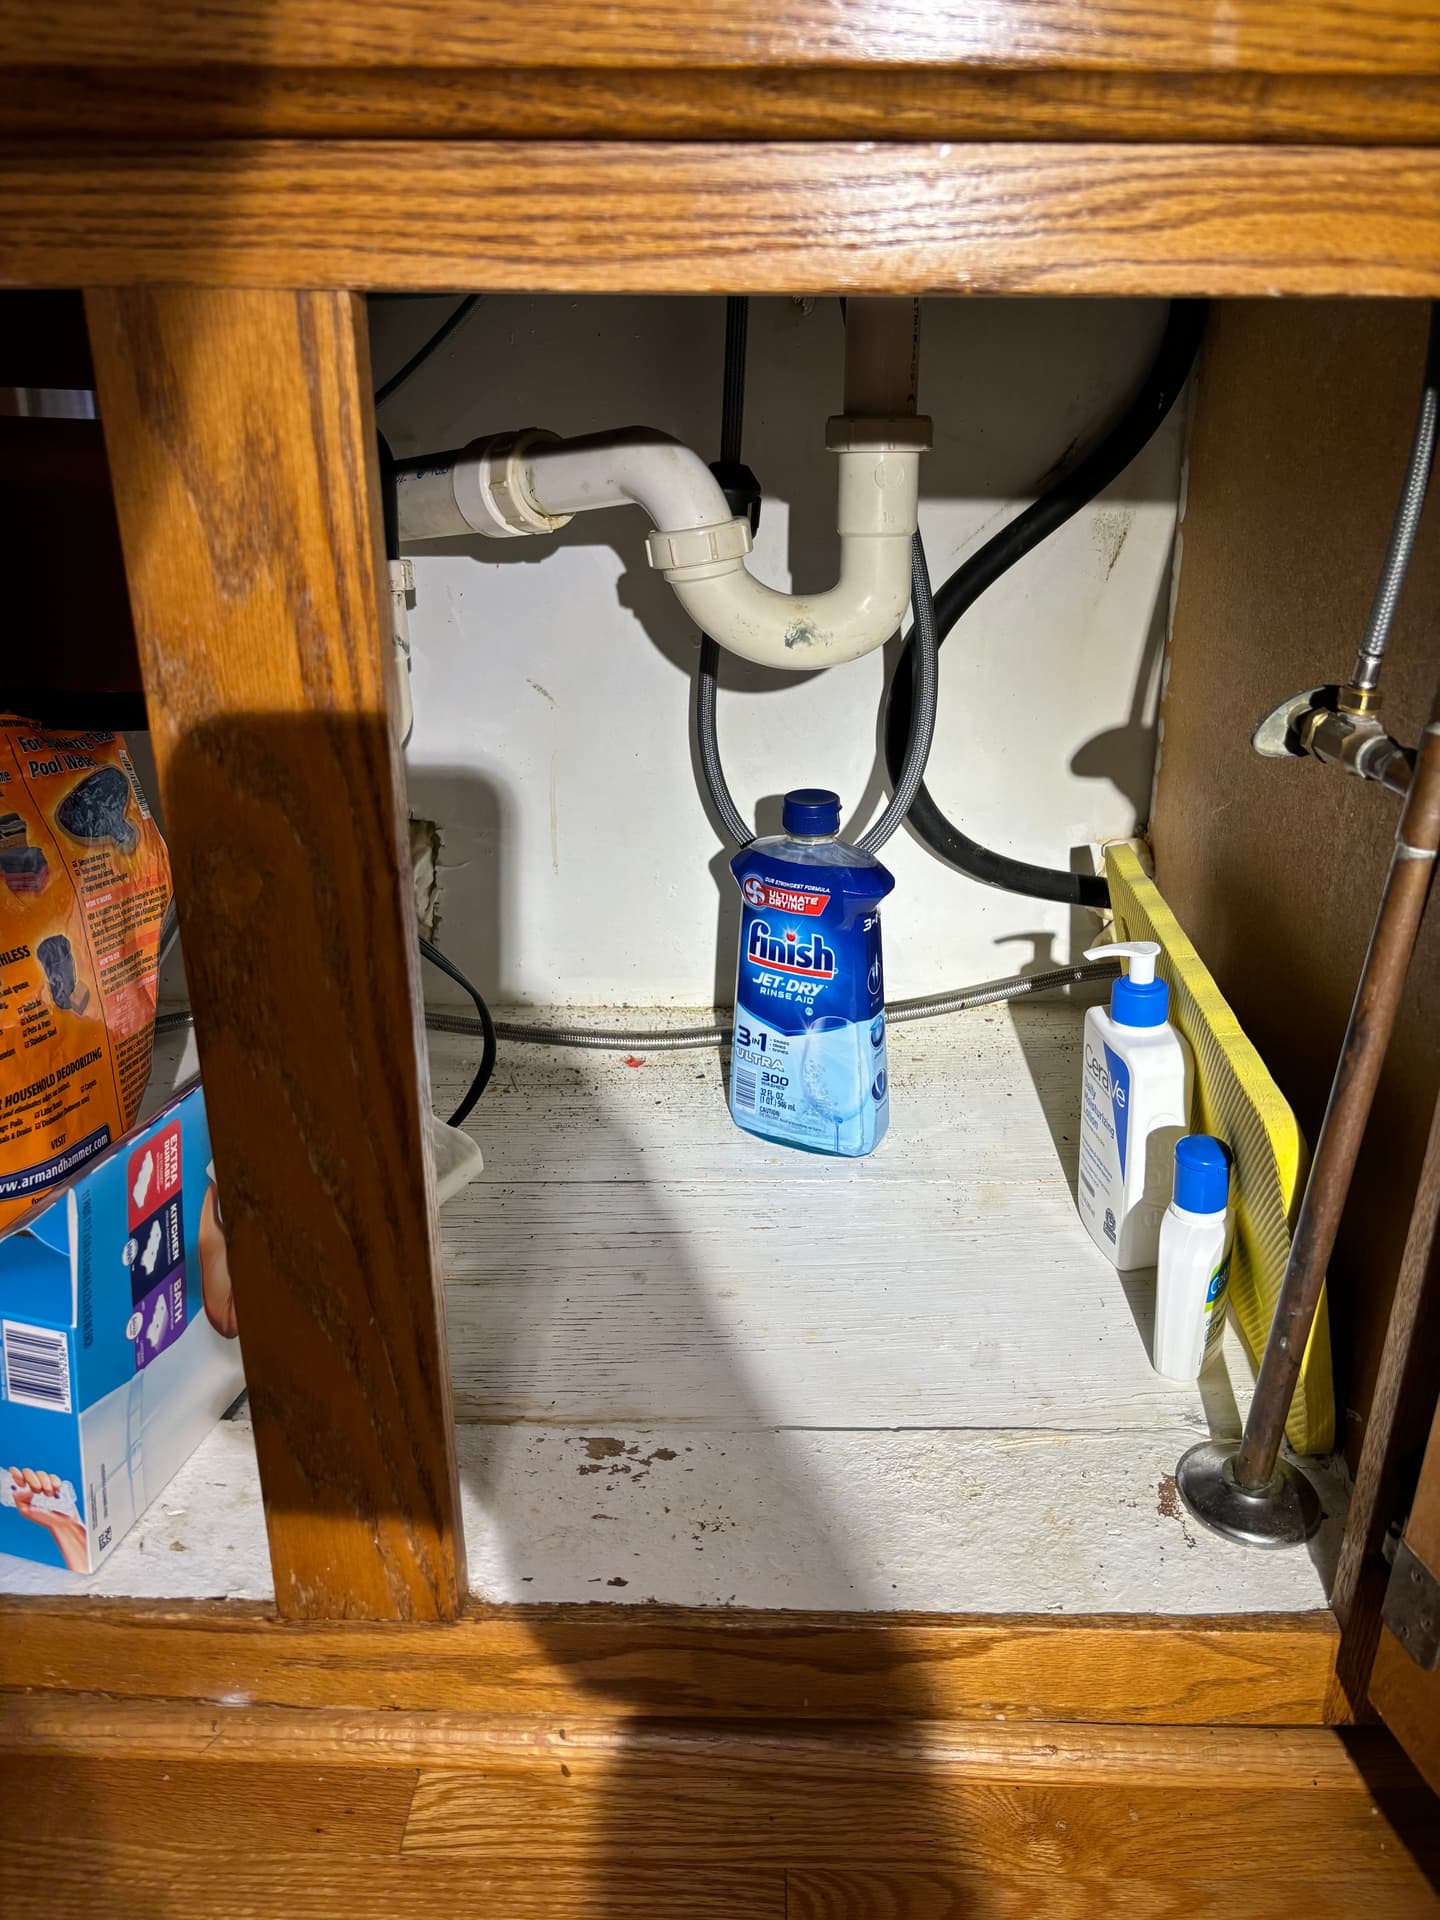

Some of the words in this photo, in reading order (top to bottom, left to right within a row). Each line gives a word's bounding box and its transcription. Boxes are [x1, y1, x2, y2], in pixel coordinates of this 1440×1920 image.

[17, 736, 42, 753] For
[28, 755, 63, 779] Pool
[64, 754, 96, 771] Wate
[764, 876, 775, 885] OUR
[775, 879, 804, 890] STRONGEST
[768, 898, 805, 912] DRYING
[769, 889, 819, 906] ULTIMATE
[748, 919, 835, 972] finish
[752, 971, 824, 997] JET-DRY
[760, 987, 792, 1001] RINSE
[795, 994, 814, 1005] AID
[736, 1045, 785, 1073] ULTRA
[5, 1073, 55, 1108] HOUSEHOLD
[56, 1047, 102, 1080] DEODORIZING
[761, 1072, 789, 1087] 300
[1085, 1043, 1126, 1108] CeraVe
[50, 1133, 66, 1150] VISIT
[163, 1139, 171, 1191] DURABLE
[170, 1134, 178, 1185] EXTRA
[170, 1202, 179, 1262] KITCHEN
[174, 1277, 183, 1324] BATH
